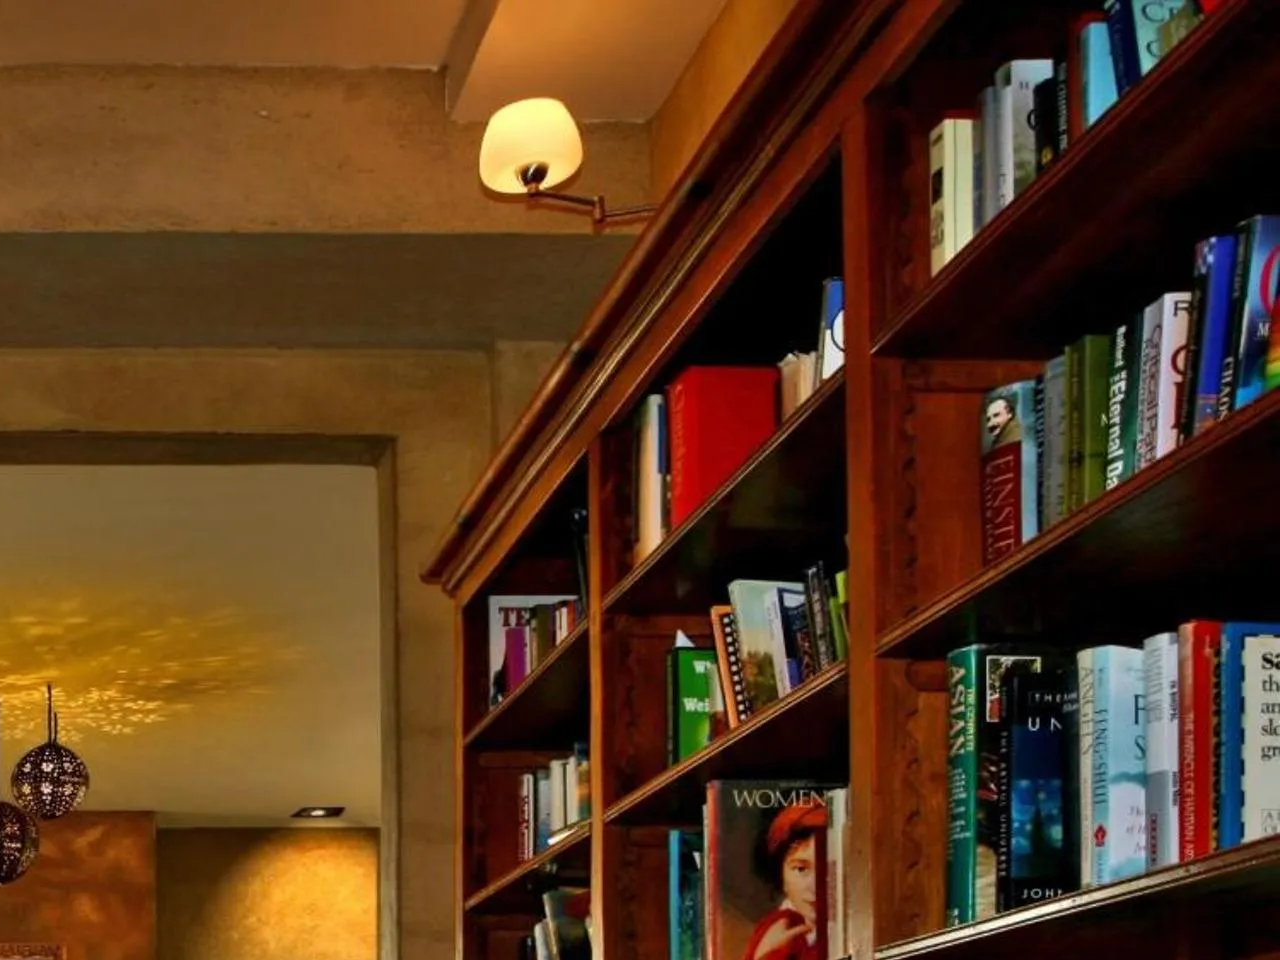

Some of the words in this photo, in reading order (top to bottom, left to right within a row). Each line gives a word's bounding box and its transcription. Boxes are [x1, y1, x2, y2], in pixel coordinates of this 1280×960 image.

[1107, 379, 1126, 460] Eternal
[948, 665, 966, 756] ASIAN
[733, 789, 828, 808] WOMEN
[999, 815, 1008, 877] UNIVERSE
